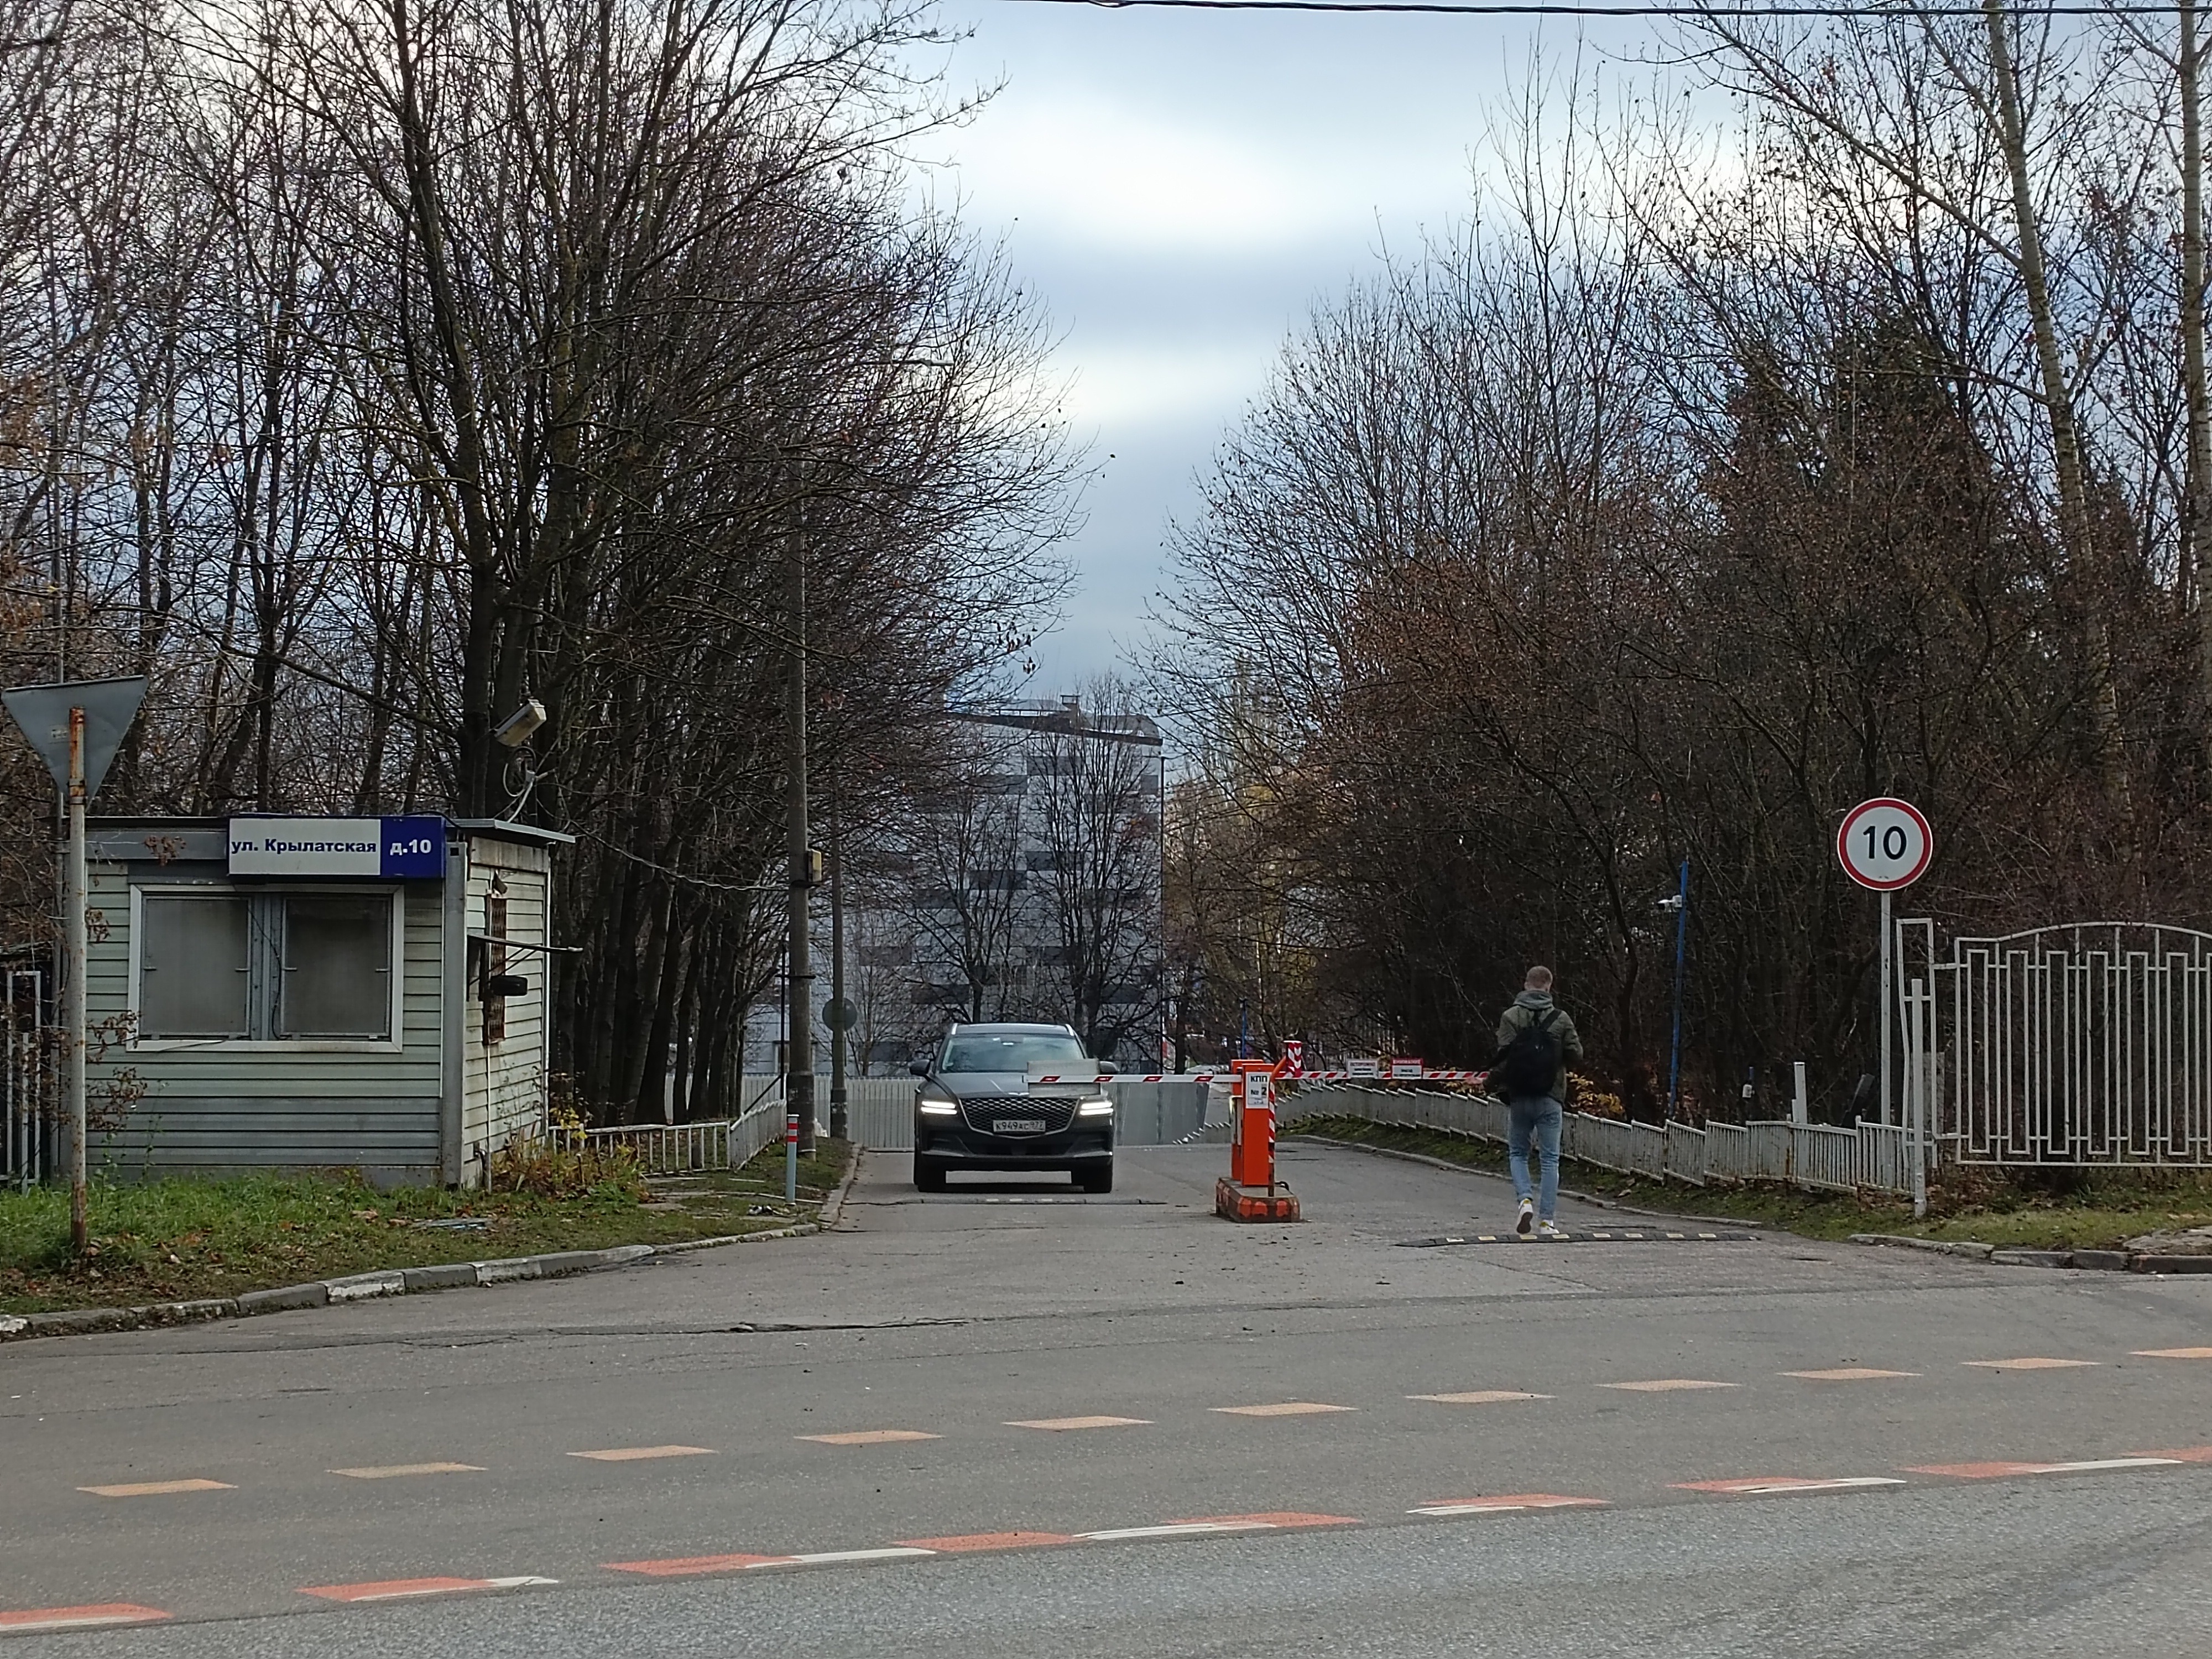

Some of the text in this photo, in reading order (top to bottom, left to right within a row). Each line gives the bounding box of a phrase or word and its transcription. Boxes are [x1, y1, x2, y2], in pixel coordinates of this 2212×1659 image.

[231, 838, 377, 855] ул. Крылатская
[390, 839, 431, 855] д.10
[1863, 826, 1907, 860] 10
[1261, 1087, 1267, 1095] 2
